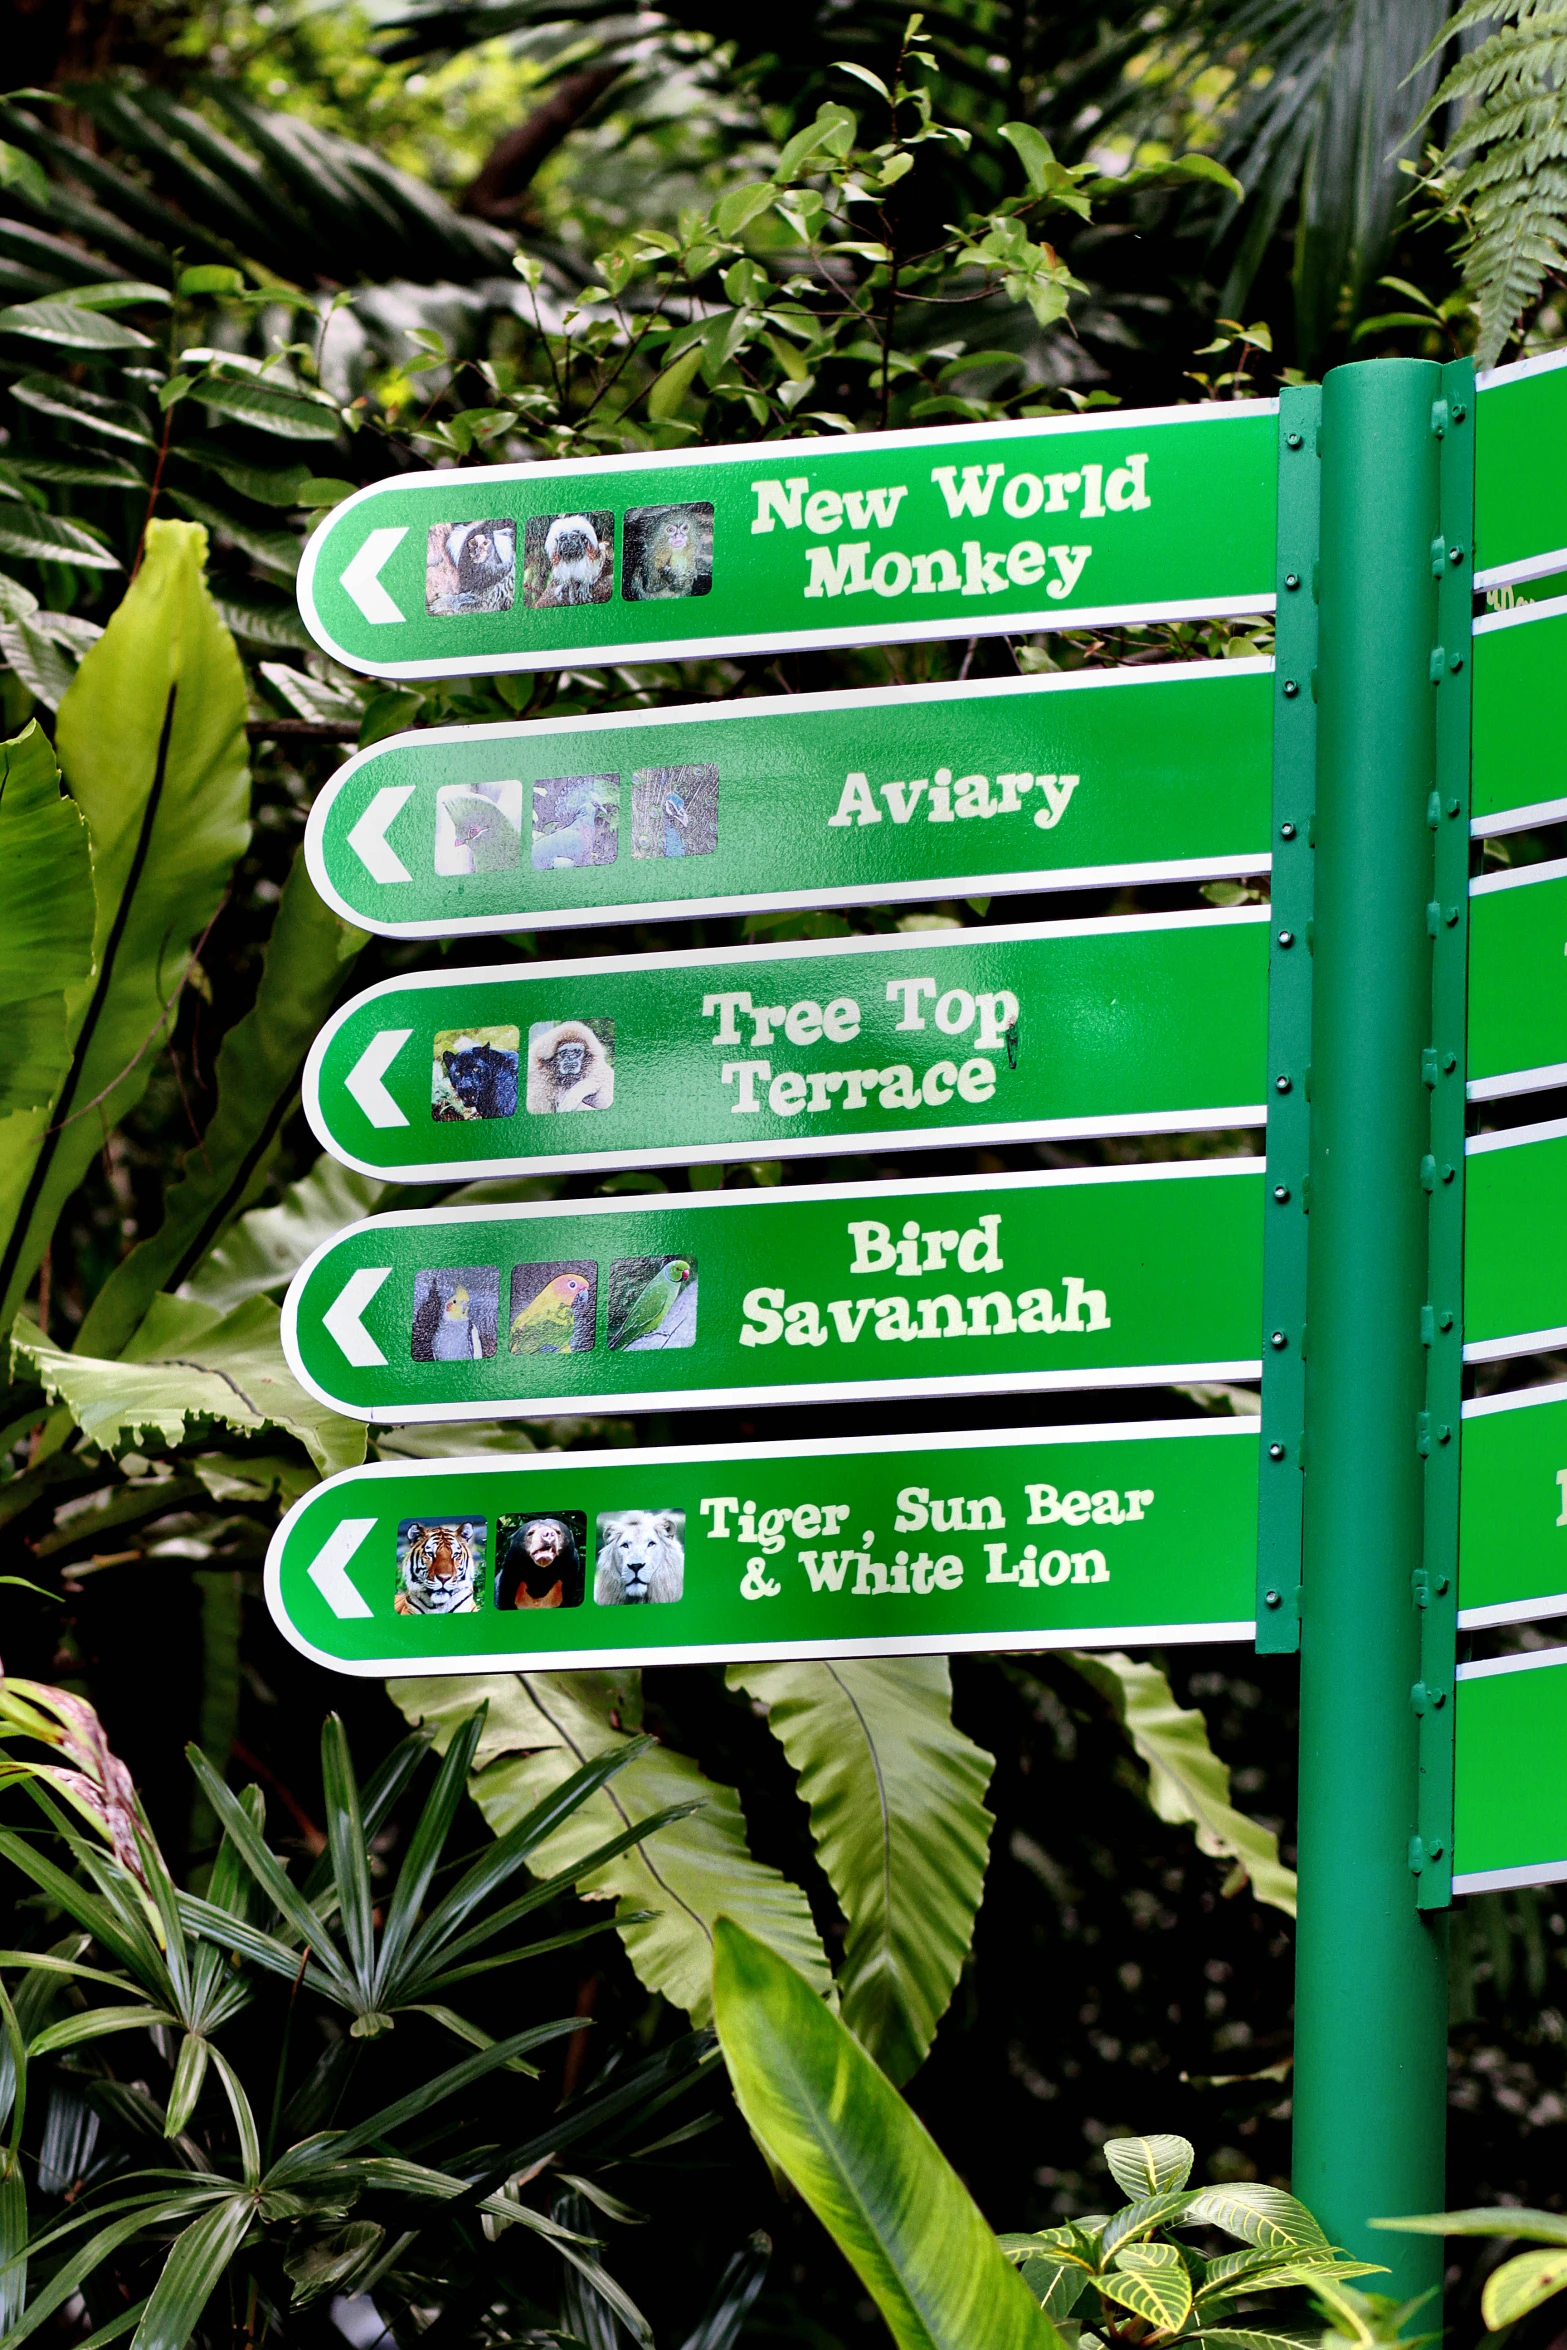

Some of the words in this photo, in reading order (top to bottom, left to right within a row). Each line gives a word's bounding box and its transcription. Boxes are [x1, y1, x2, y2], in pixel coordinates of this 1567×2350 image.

[751, 478, 908, 535] New
[931, 454, 1151, 518] World
[804, 540, 1092, 600] Monkey
[828, 768, 1080, 829] Aviary
[702, 991, 861, 1046] Tree
[886, 976, 1020, 1049] Top
[721, 1058, 997, 1117] Terrace
[848, 1215, 1004, 1276] Bird
[739, 1277, 1111, 1348] Savannah
[894, 1487, 1006, 1533] Sun
[1025, 1484, 1154, 1526] Bear
[740, 1557, 781, 1600] &
[798, 1549, 964, 1595] White
[984, 1543, 1110, 1588] Lion
